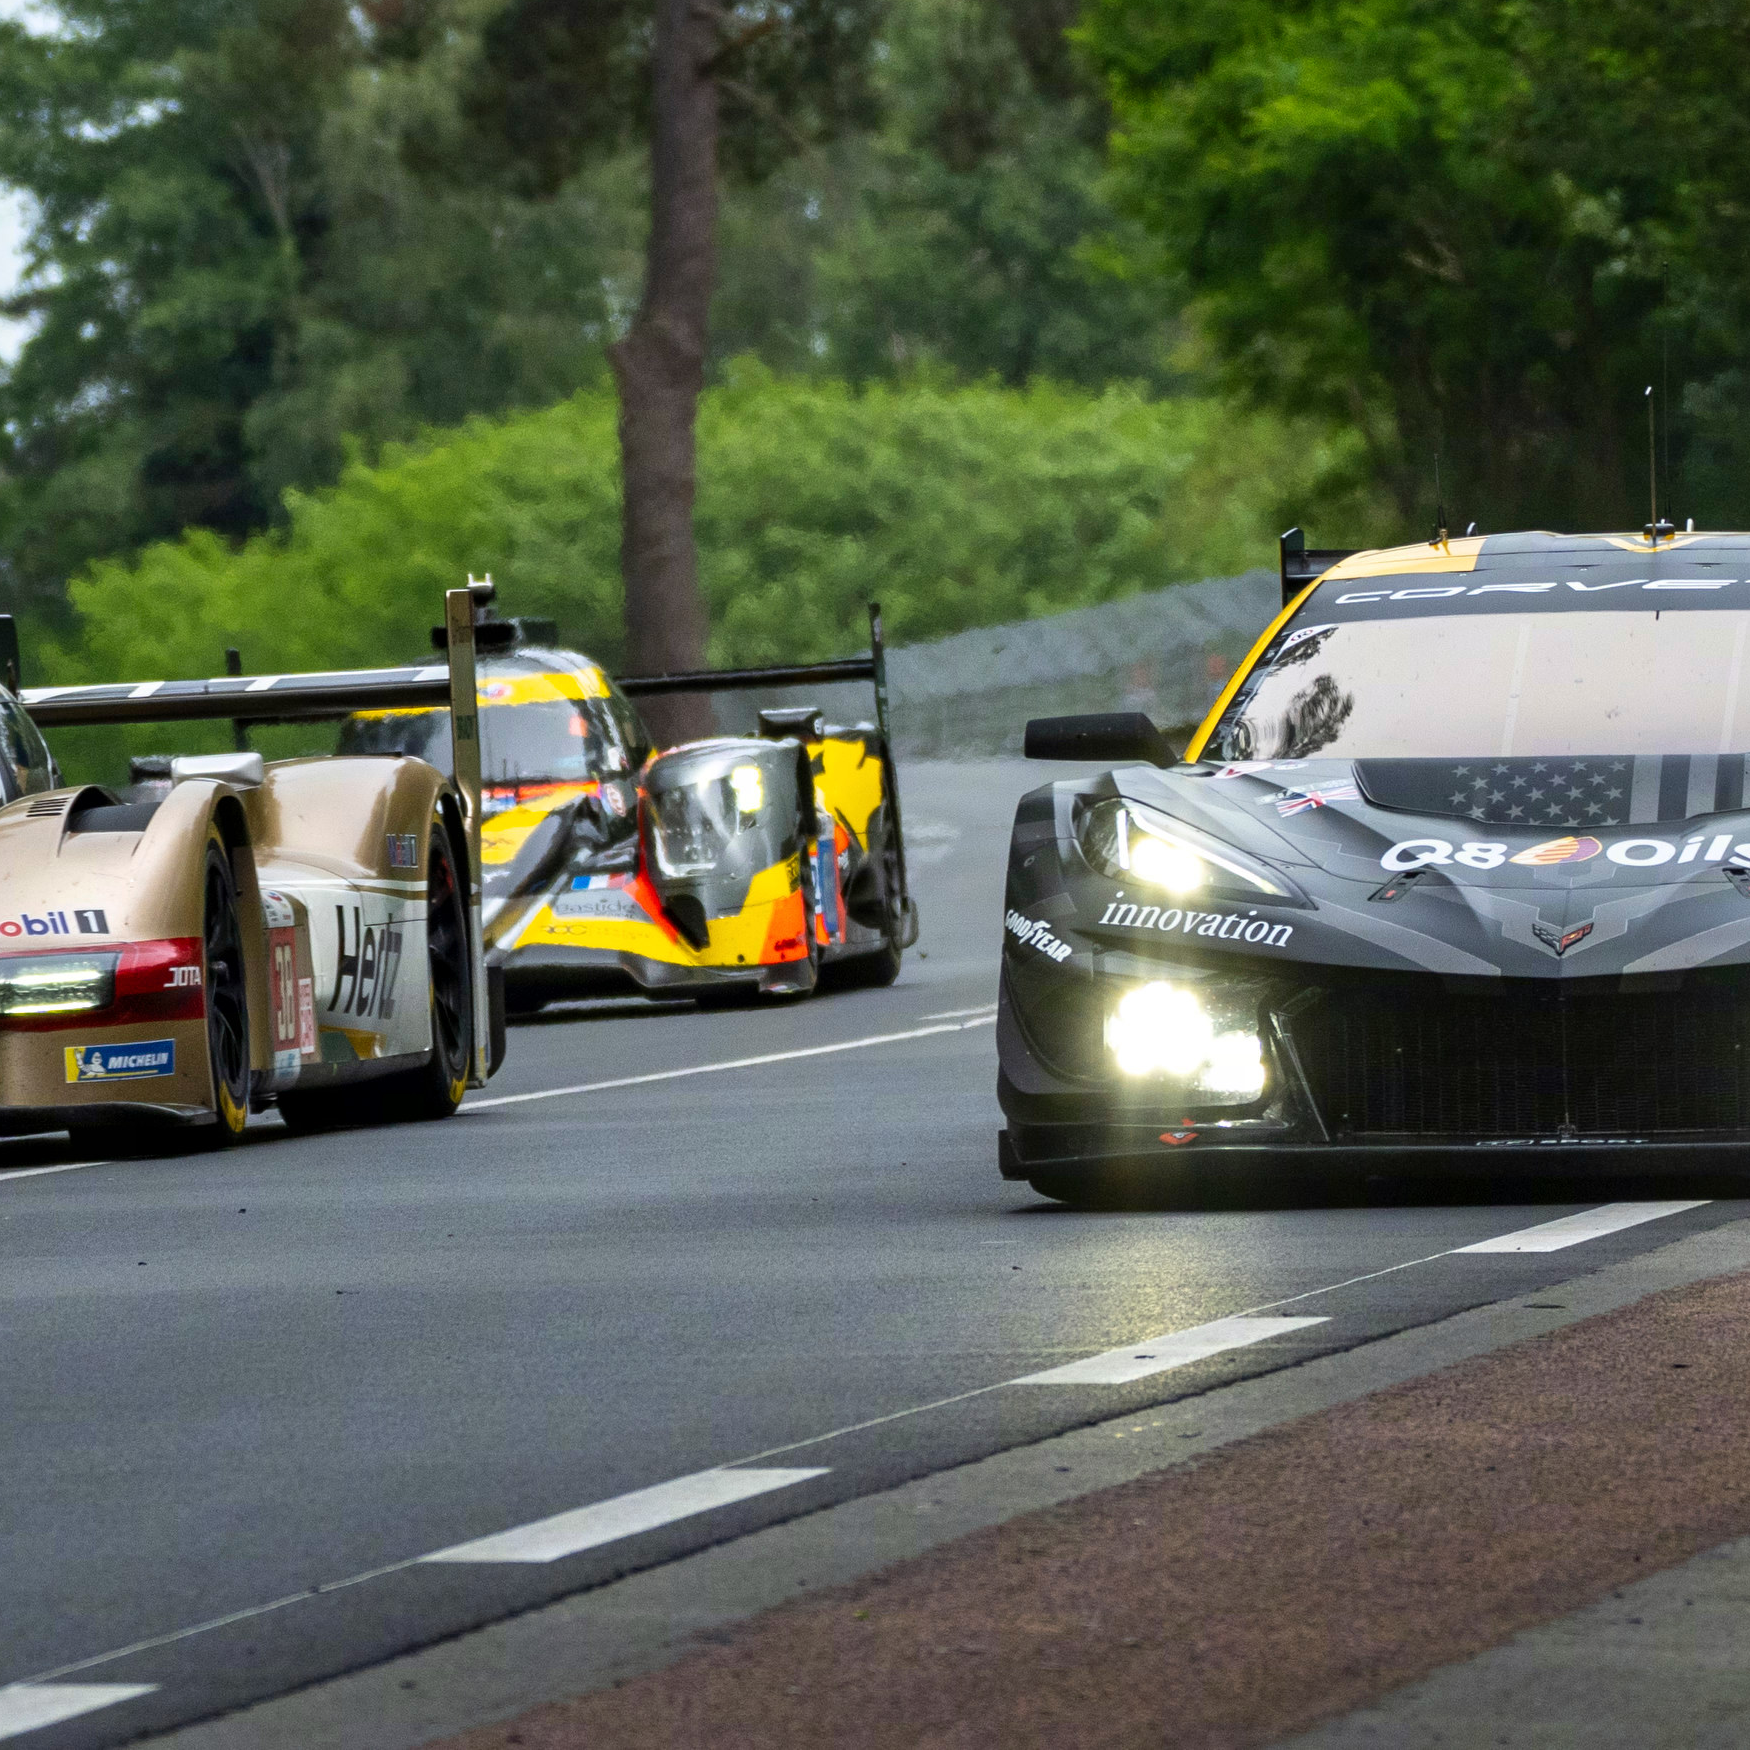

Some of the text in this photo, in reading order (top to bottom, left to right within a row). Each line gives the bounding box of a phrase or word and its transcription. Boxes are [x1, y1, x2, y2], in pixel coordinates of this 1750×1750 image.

[1005, 908, 1073, 963] GOODYEAR
[1098, 890, 1294, 948] innovation
[163, 965, 202, 988] JOTA
[326, 904, 403, 1020] Hertz
[274, 944, 296, 1041] 38
[107, 1052, 169, 1070] MICHELIN
